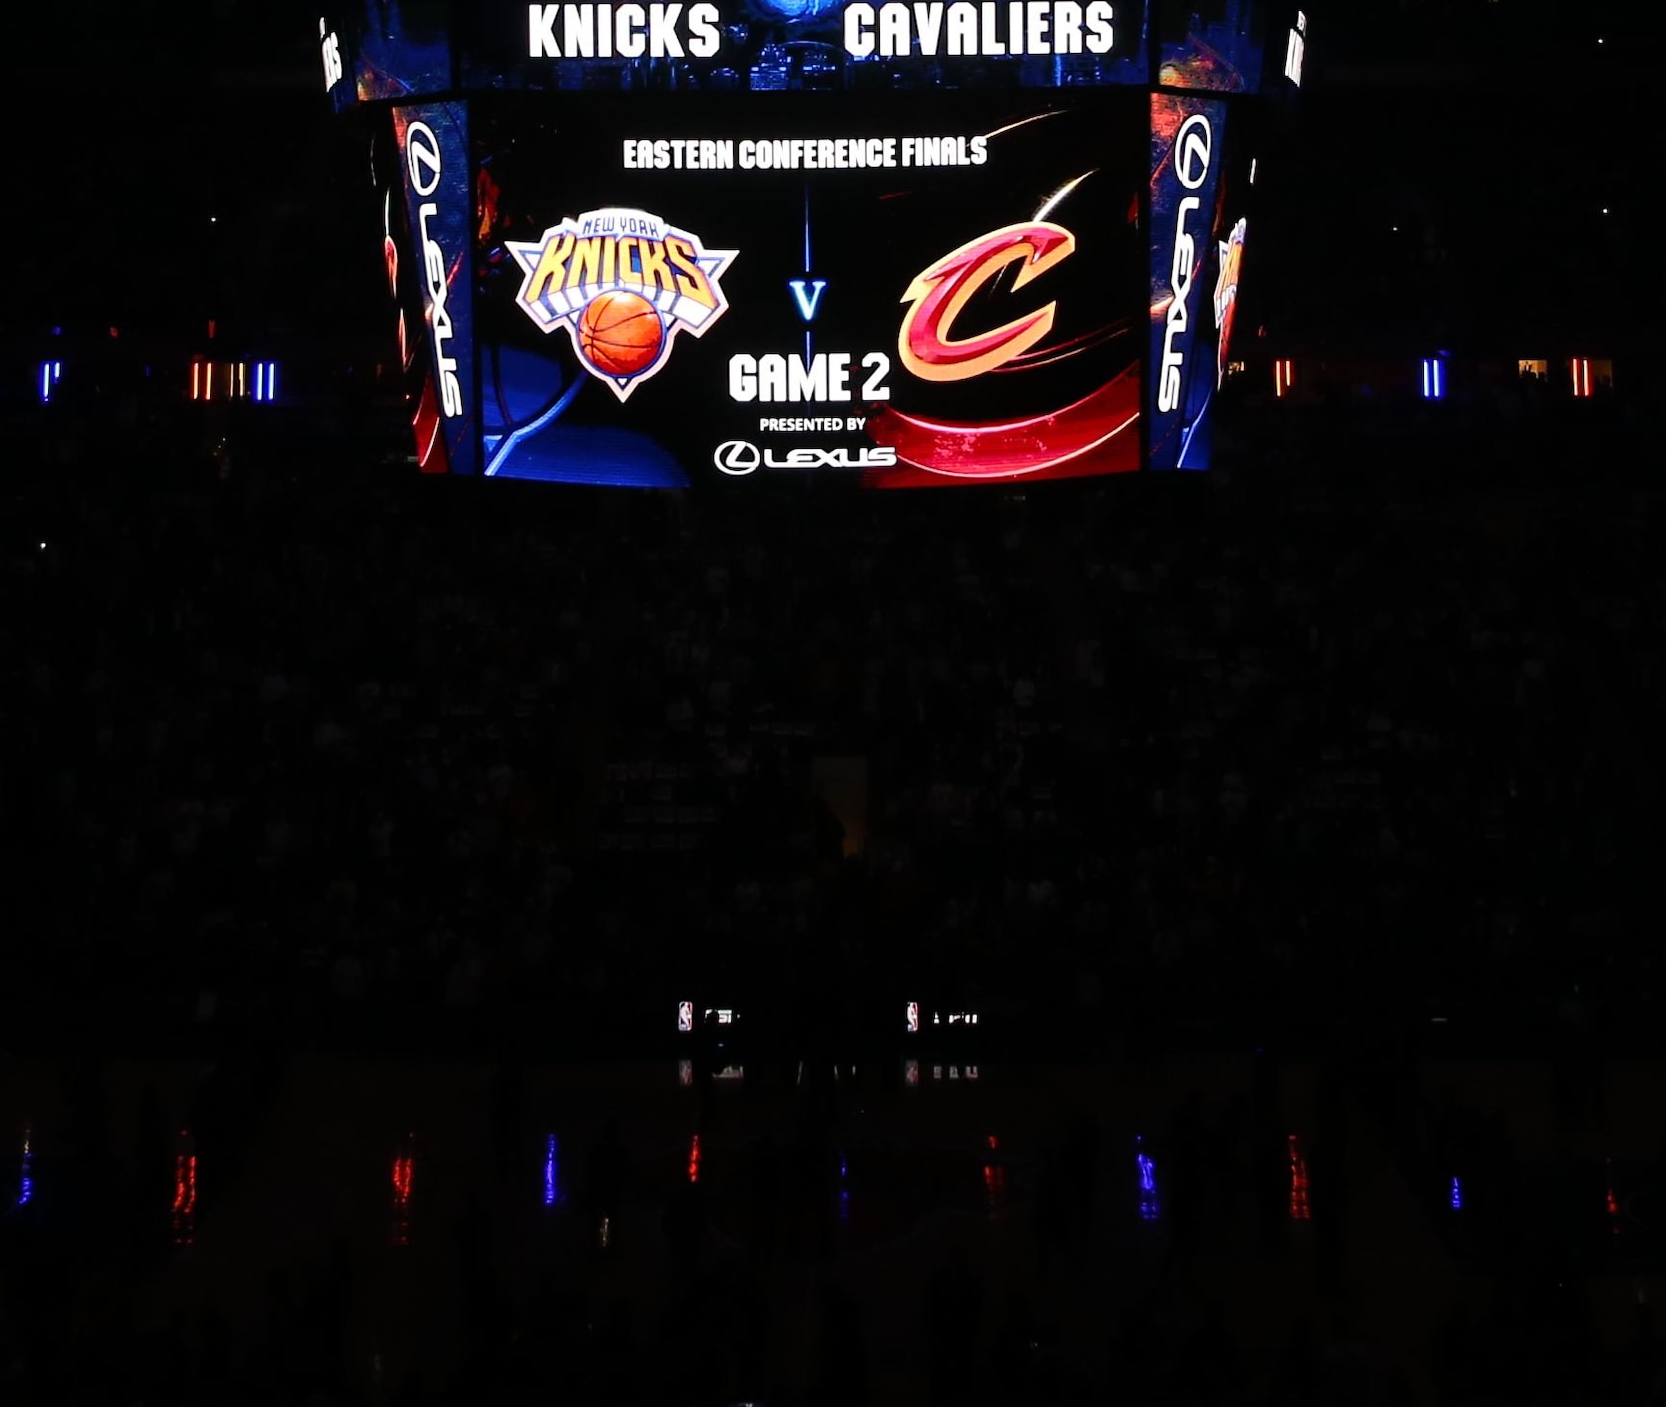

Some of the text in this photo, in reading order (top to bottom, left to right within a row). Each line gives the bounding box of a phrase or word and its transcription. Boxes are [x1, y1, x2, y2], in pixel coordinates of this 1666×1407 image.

[528, 2, 721, 58] KNICKS
[843, 0, 1114, 56] CAVALIERS
[623, 136, 988, 169] EASTERN CONFERENCE FINALS
[582, 216, 659, 238] NEW YORK
[523, 230, 721, 309] KNICKS
[419, 202, 463, 419] LEXUS
[788, 279, 827, 322] V
[1157, 196, 1200, 413] LEXUS
[729, 351, 891, 402] GAME 2
[759, 417, 867, 432] PRESENTED BY
[763, 447, 898, 468] LEXUS
